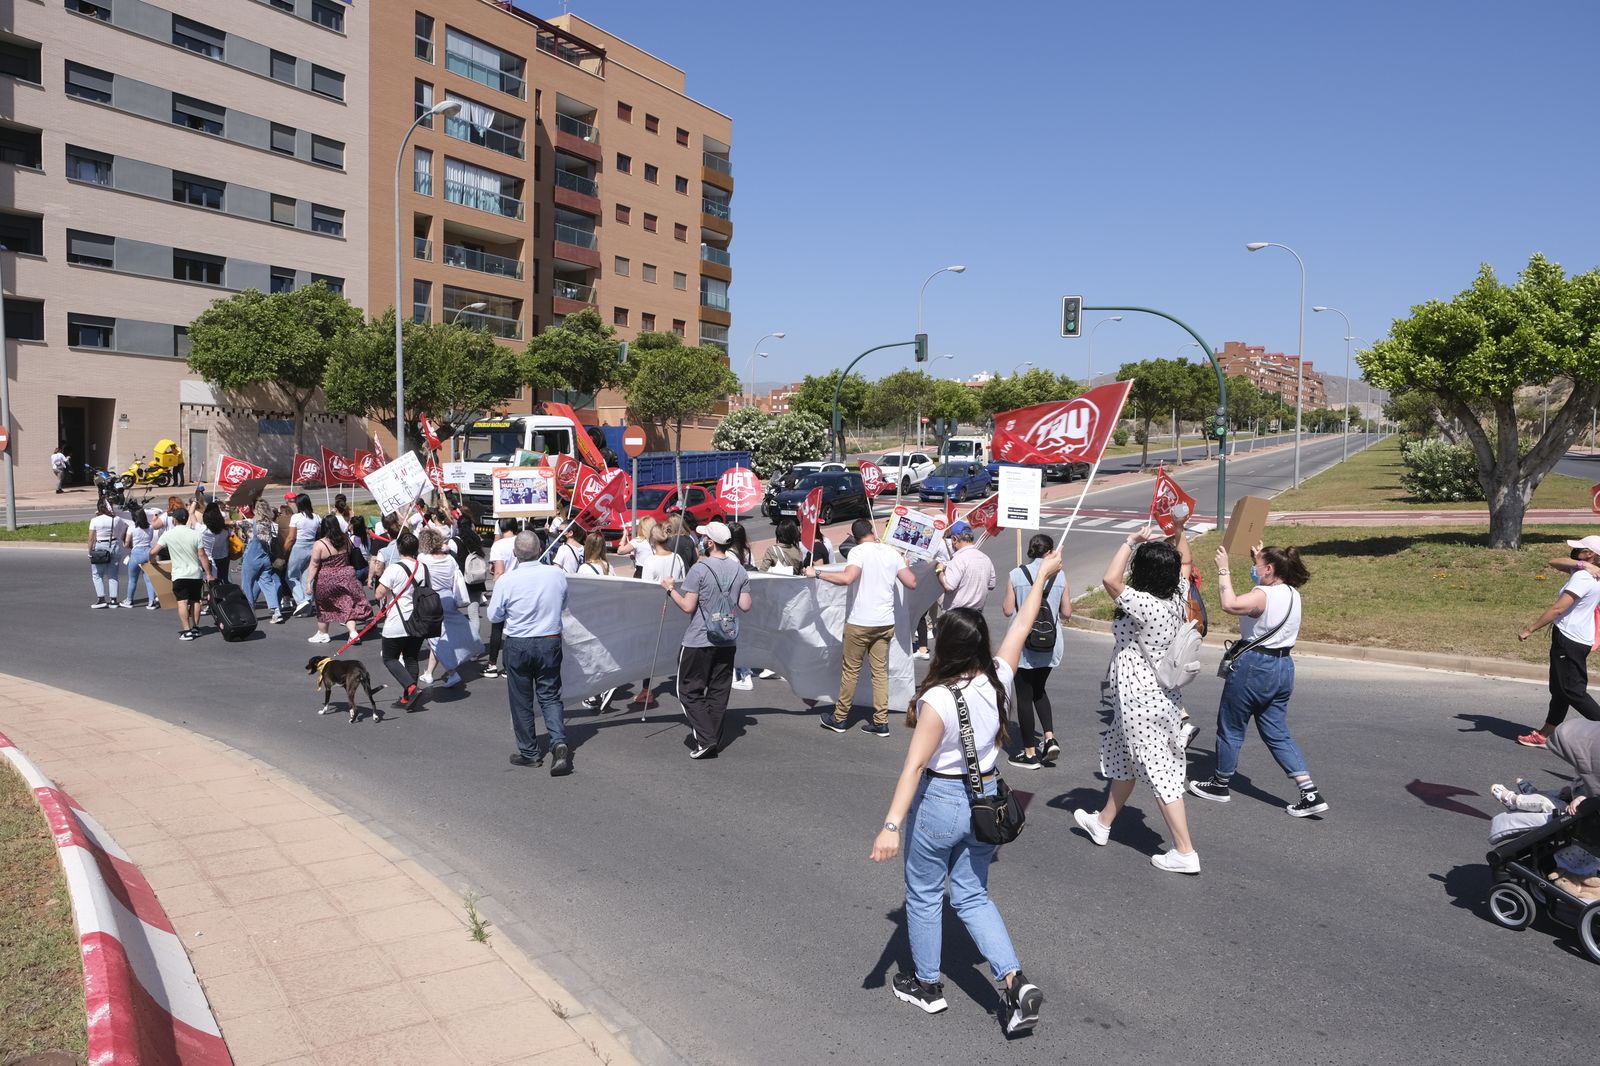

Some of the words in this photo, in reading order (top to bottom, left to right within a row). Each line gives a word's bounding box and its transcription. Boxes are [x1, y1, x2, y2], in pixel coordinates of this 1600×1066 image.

[722, 471, 753, 491] UGT
[382, 493, 401, 513] ERE
[957, 695, 968, 720] LOLA
[969, 762, 980, 788] LOLA
